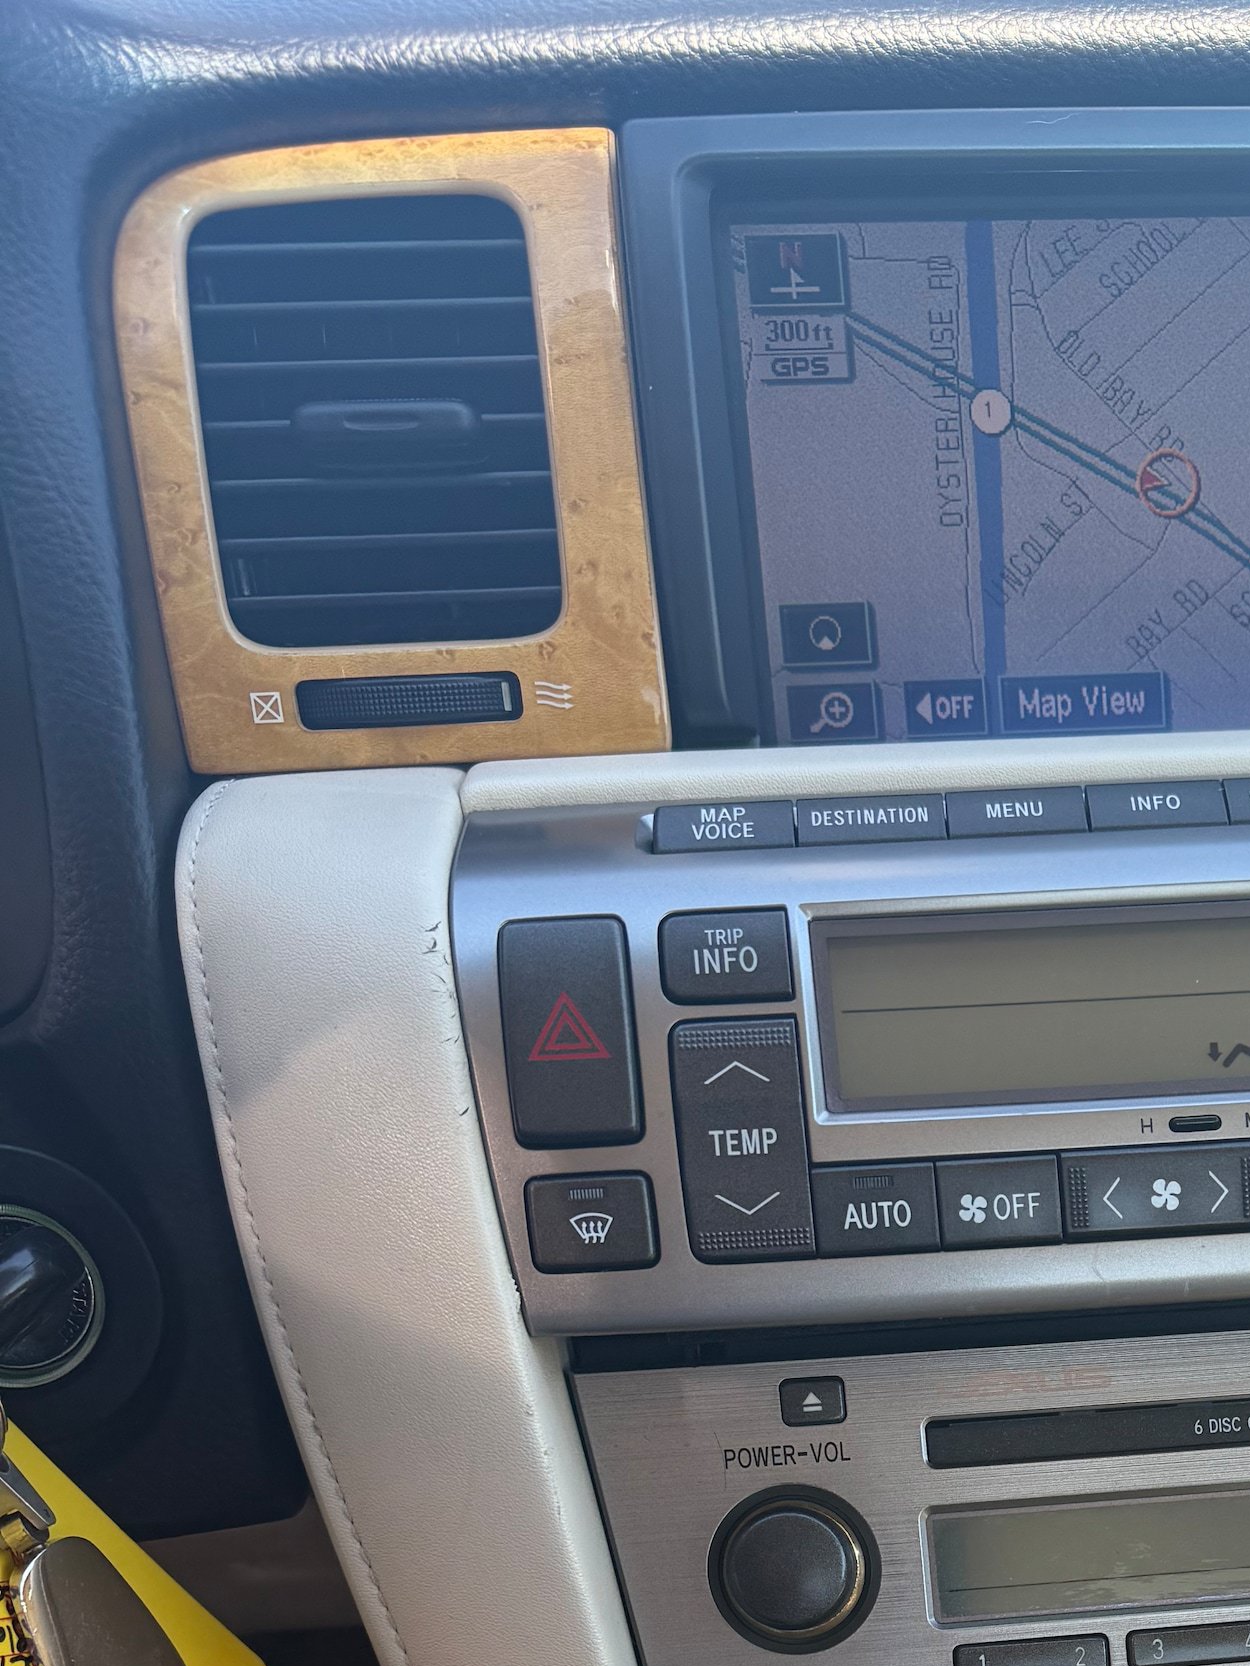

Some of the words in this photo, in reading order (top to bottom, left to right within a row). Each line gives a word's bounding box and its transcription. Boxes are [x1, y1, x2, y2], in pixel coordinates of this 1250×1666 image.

[1040, 224, 1090, 278] LEE
[928, 309, 958, 400] HOUSE
[770, 356, 831, 379] GPS
[1054, 330, 1102, 377] OLD
[1102, 375, 1152, 423] BAY
[984, 400, 993, 419] 1
[935, 416, 965, 527] OYSTER
[1125, 610, 1171, 658] BAY
[1174, 578, 1212, 612] RD
[935, 694, 975, 720] OFF
[1018, 688, 1073, 727] Map
[1081, 685, 1147, 715] View
[700, 806, 746, 823] MAP
[984, 801, 1044, 819] MENU
[1129, 794, 1182, 813] INFO
[810, 806, 930, 828] DESTINATION
[692, 822, 755, 841] VOICE
[704, 928, 744, 946] TRIP
[693, 946, 759, 975] INFO
[1140, 1117, 1154, 1134] H
[708, 1126, 778, 1158] TEMP
[843, 1198, 912, 1231] AUTO
[992, 1190, 1042, 1221] OFF
[1193, 1418, 1204, 1435] 6
[1208, 1414, 1242, 1434] DISC
[723, 1441, 852, 1470] POWER-VOL
[1075, 1647, 1087, 1666] 2
[1151, 1640, 1164, 1660] 3
